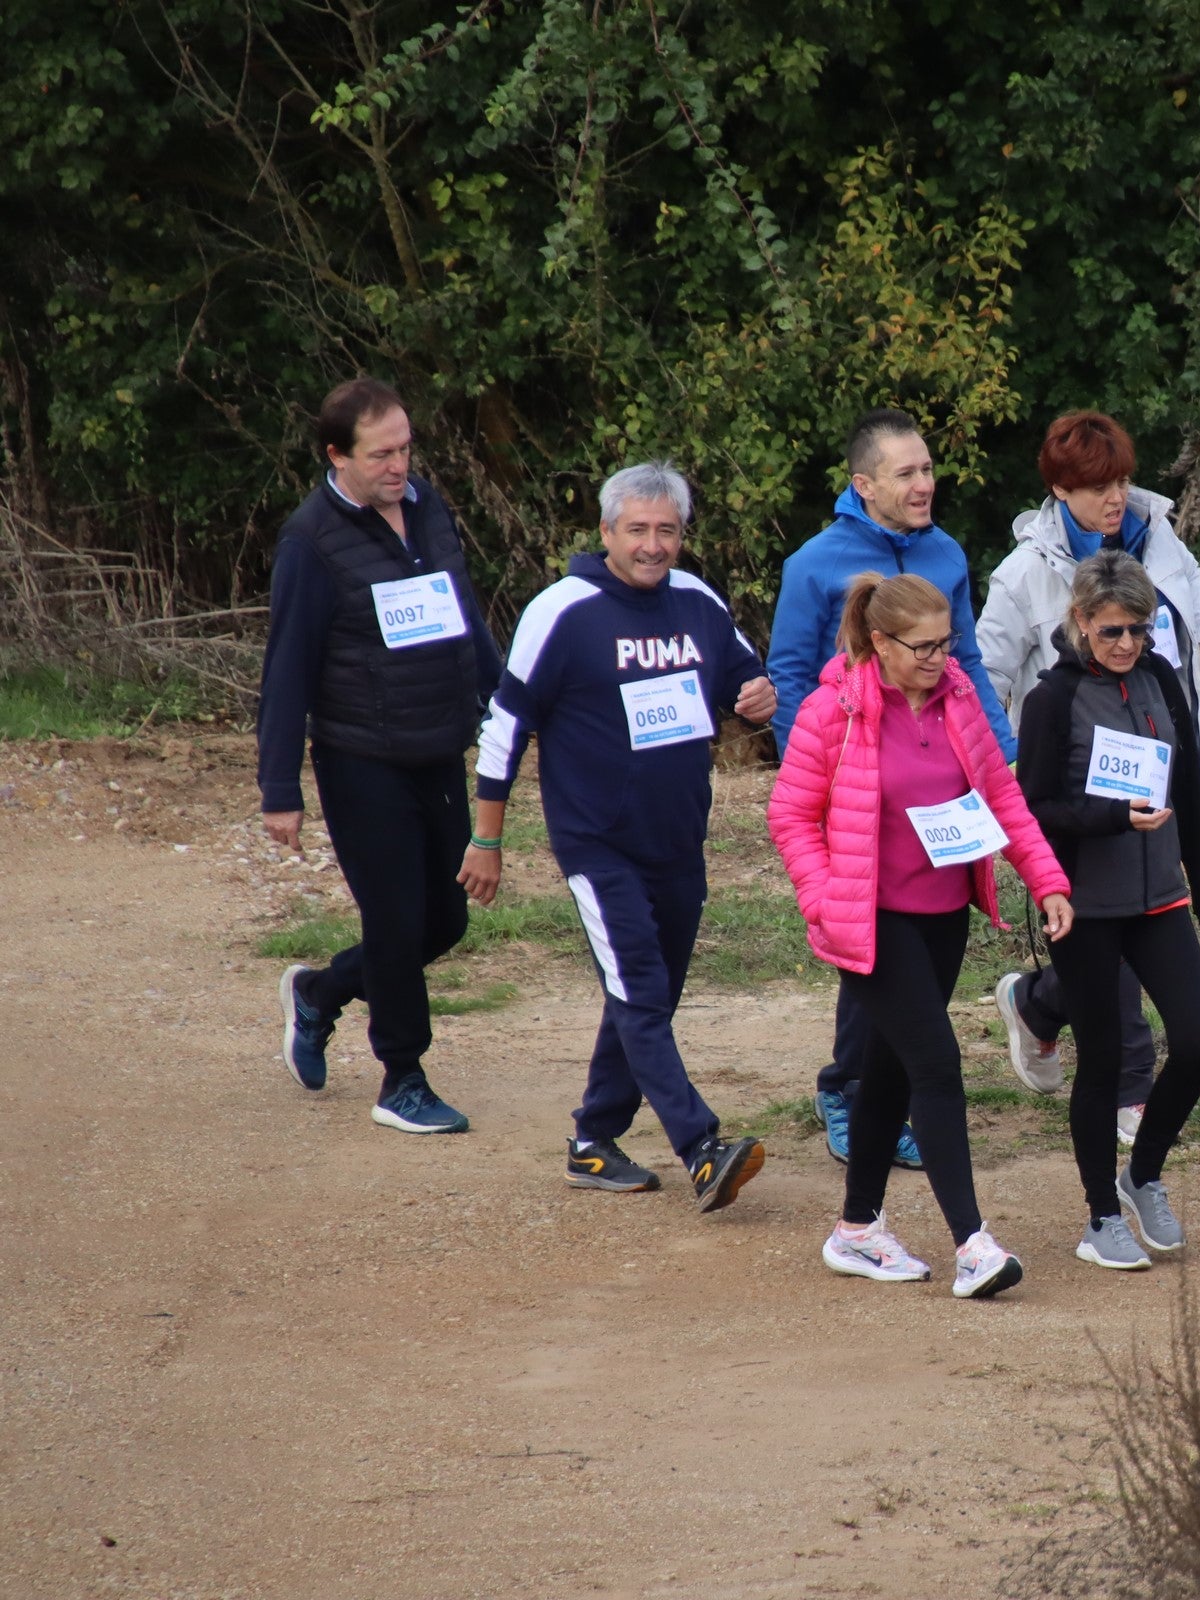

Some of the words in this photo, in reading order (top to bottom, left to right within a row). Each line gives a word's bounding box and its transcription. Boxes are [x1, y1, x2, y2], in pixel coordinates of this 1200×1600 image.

[384, 604, 424, 626] 0097
[616, 633, 703, 670] PUMA
[636, 705, 677, 727] 0680
[1099, 754, 1139, 779] 0381
[925, 825, 961, 843] 0020
